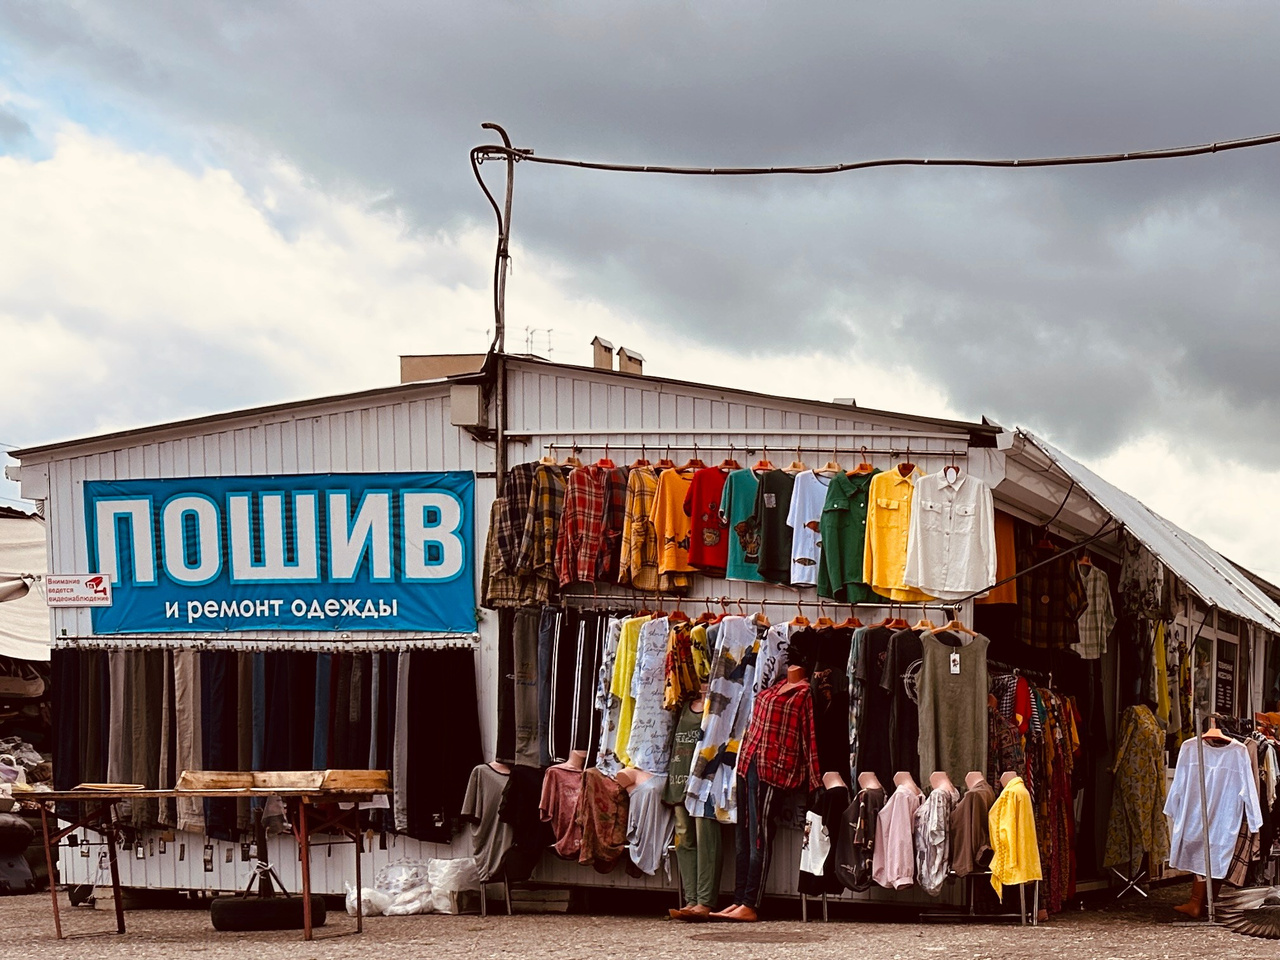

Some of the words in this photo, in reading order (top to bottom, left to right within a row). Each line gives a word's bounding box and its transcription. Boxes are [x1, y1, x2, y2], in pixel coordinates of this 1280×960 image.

[94, 490, 464, 587] ПОШИВ
[165, 603, 179, 618] и
[187, 598, 284, 624] ремонт
[291, 598, 398, 619] одежды
